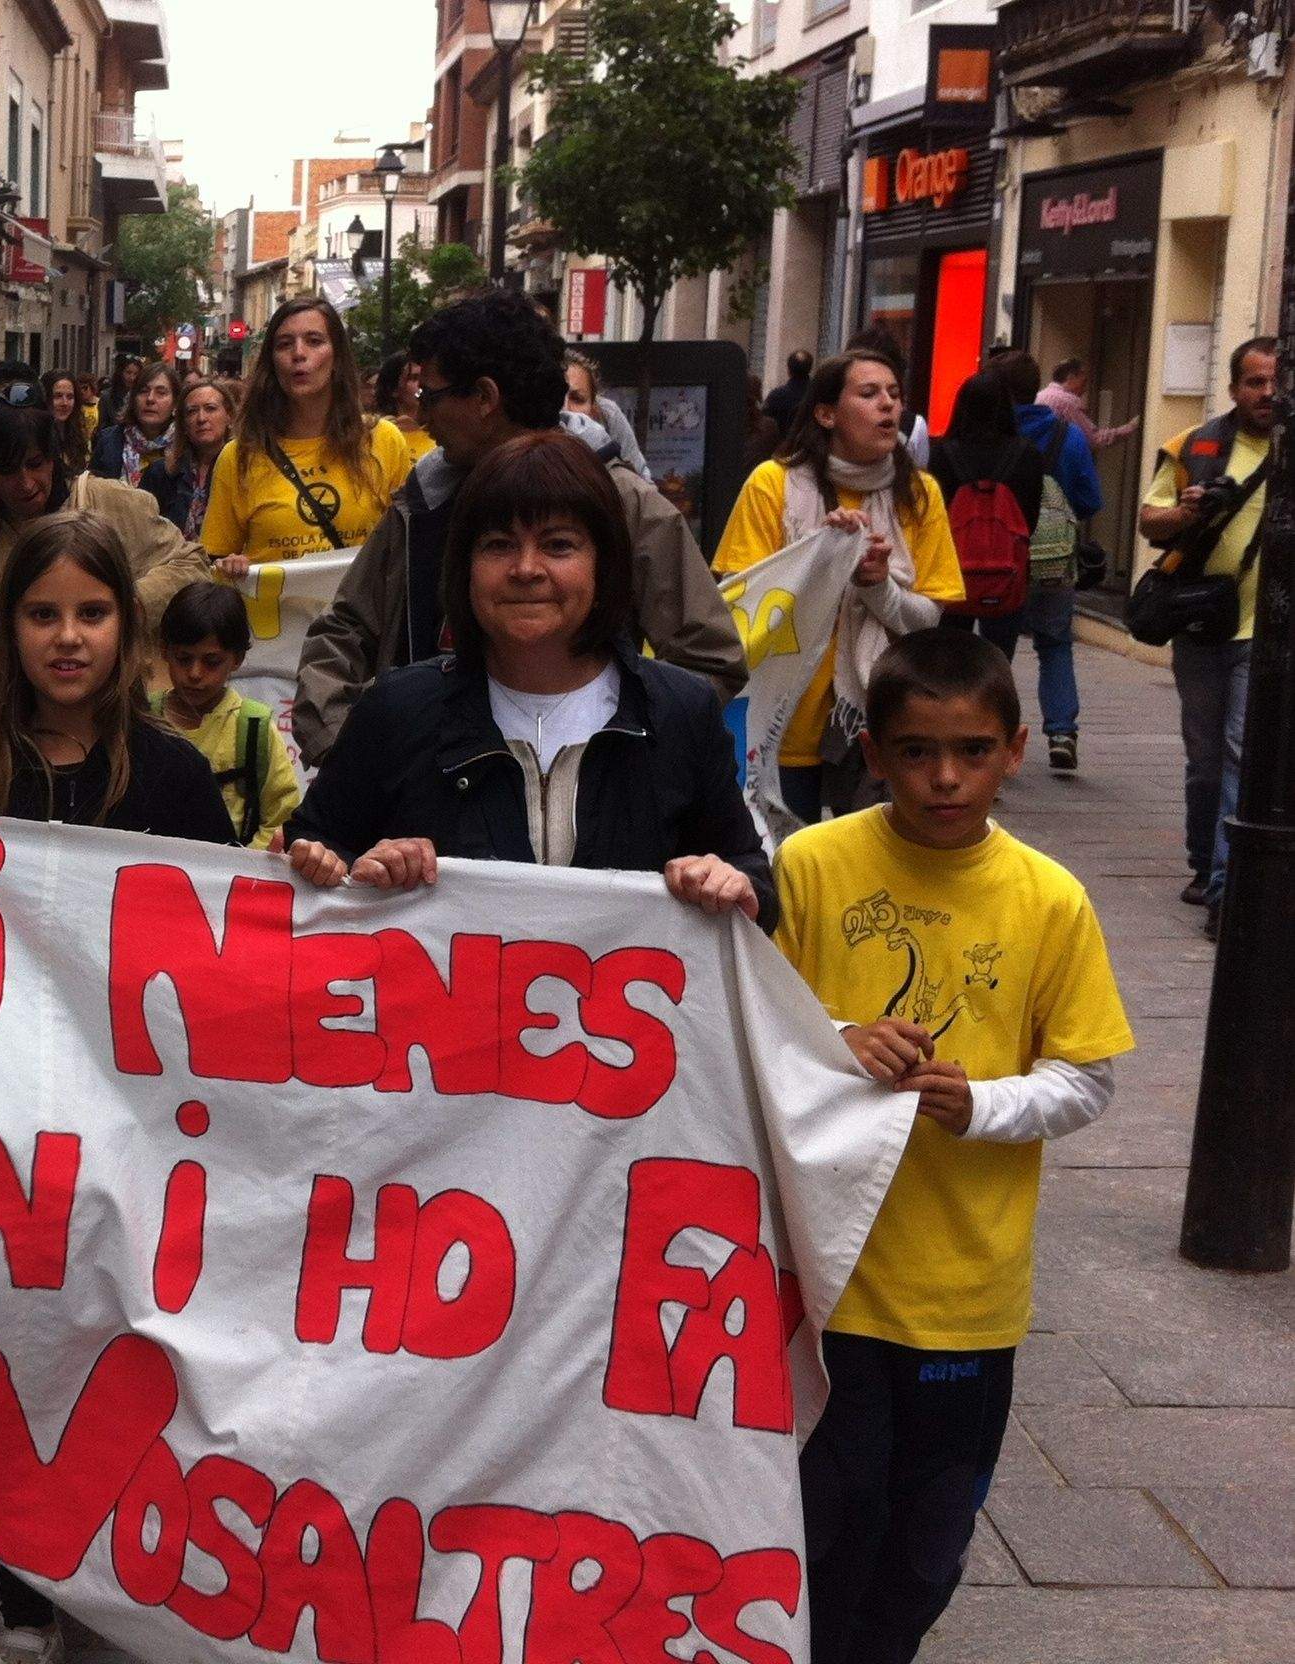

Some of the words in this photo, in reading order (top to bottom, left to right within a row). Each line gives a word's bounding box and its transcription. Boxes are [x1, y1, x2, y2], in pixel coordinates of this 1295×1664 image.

[895, 148, 968, 208] Orange
[841, 888, 900, 950] 25
[108, 863, 685, 1120] NENES
[294, 1173, 517, 1360] HO
